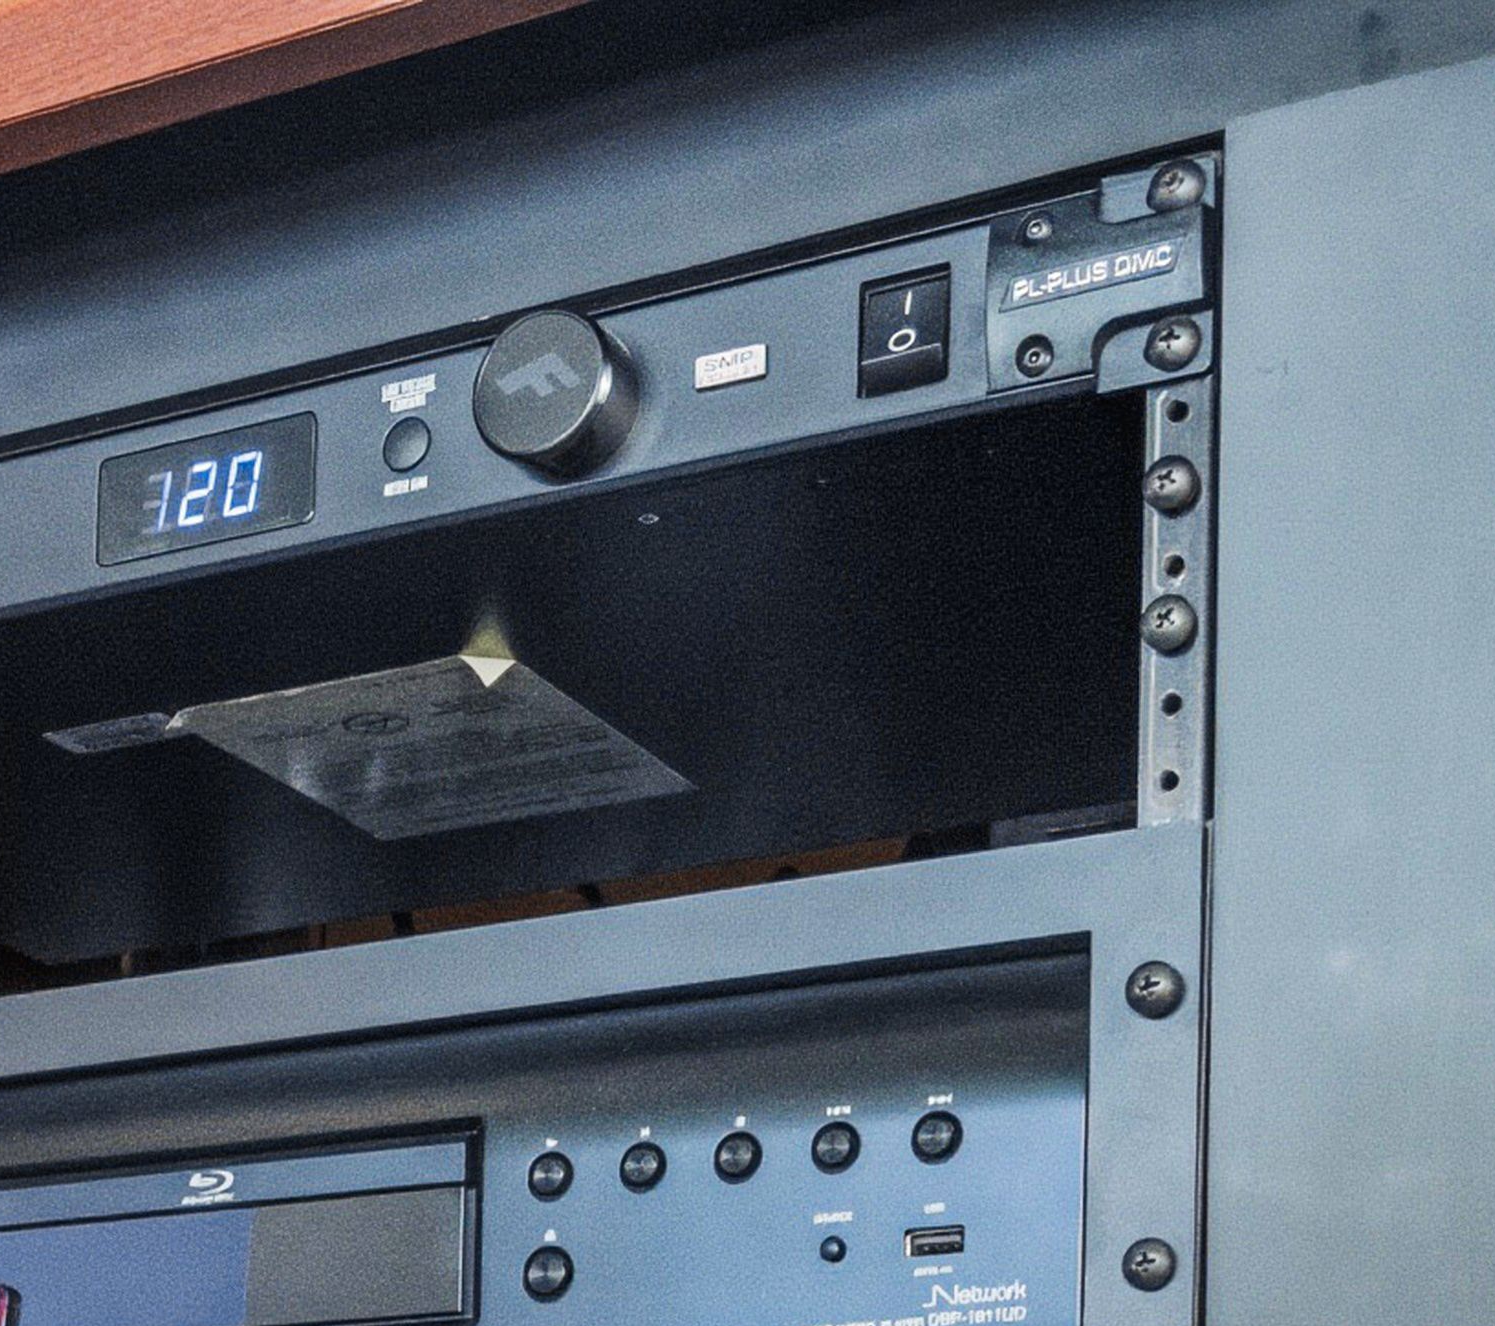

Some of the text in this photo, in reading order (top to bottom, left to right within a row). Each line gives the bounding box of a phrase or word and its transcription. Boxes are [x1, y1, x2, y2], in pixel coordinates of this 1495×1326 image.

[1012, 244, 1175, 300] PL-PLUS DMC
[159, 450, 263, 532] 120
[923, 1282, 1028, 1308] Network
